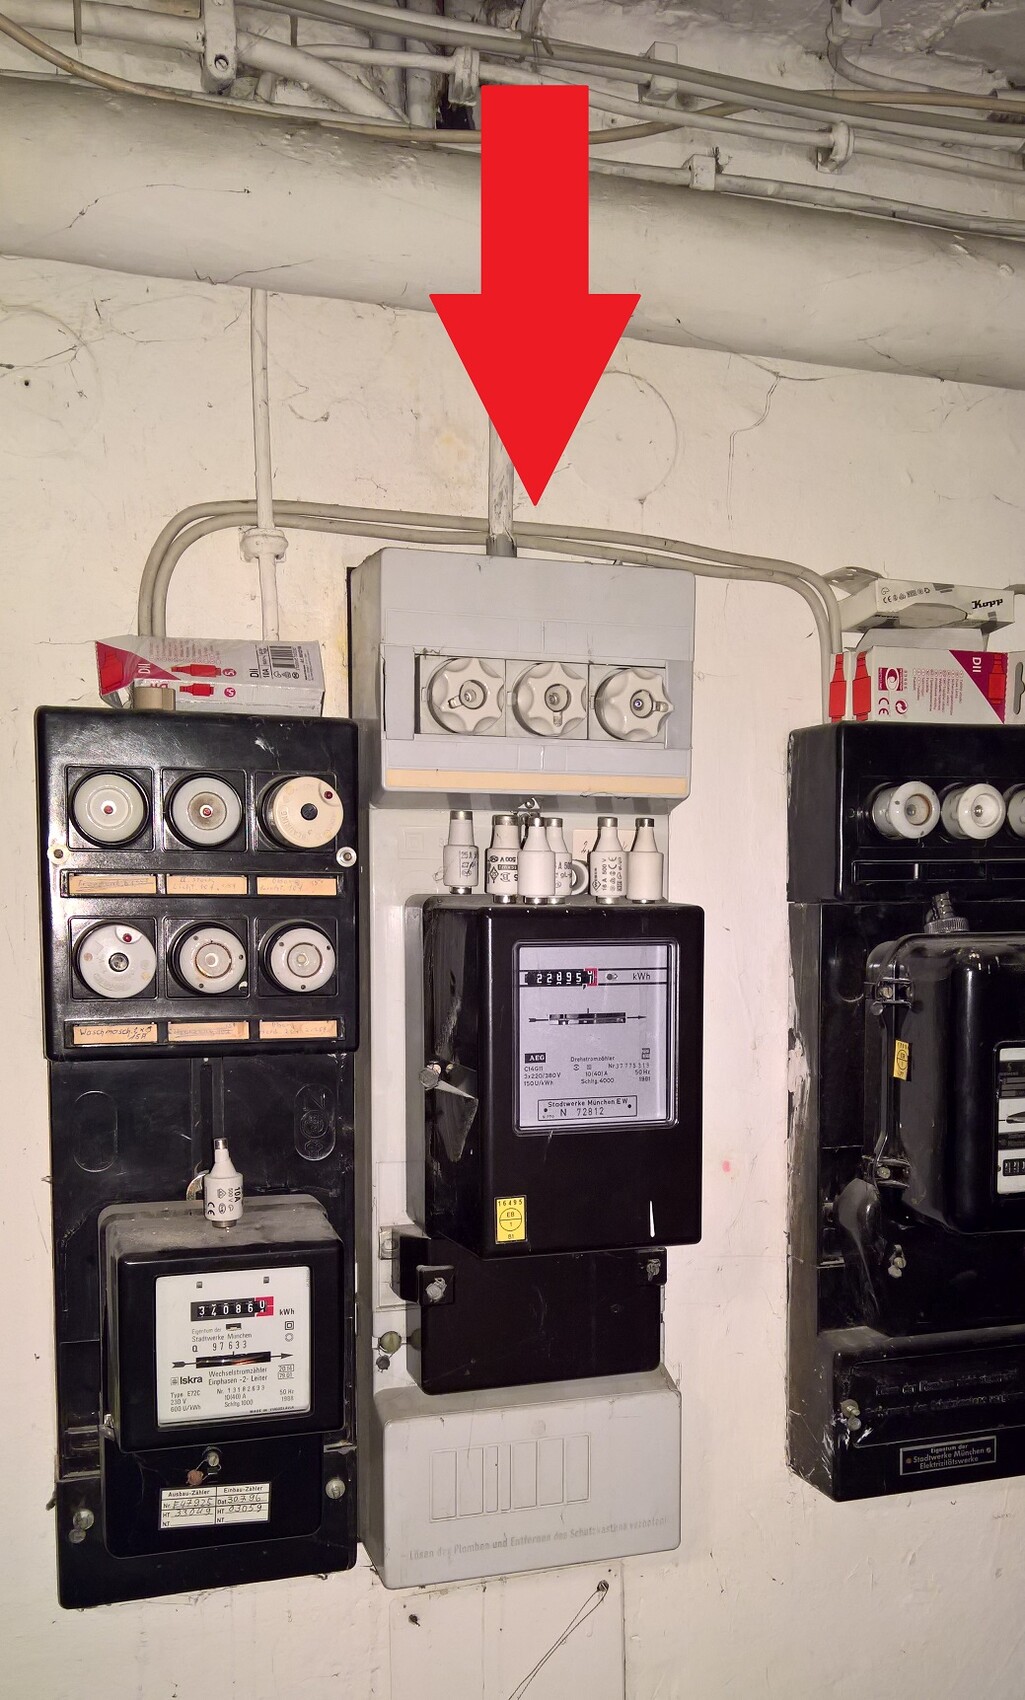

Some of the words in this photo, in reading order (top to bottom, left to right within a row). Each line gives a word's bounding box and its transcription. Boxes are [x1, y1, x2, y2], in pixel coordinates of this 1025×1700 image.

[972, 598, 1003, 610] Kopp
[972, 657, 982, 673] DII
[632, 972, 651, 980] kWh
[528, 1053, 546, 1062] AEG
[576, 1107, 605, 1116] 72812
[279, 1308, 295, 1316] kWh
[192, 1335, 225, 1343] Stadtwerke
[212, 1340, 247, 1351] 97633
[208, 1367, 268, 1378] Wechselstromzähler
[180, 1376, 203, 1385] Iskra
[208, 1377, 238, 1386] Einphasen
[913, 1453, 952, 1463] Stadtwerke
[953, 1448, 985, 1458] München
[920, 1457, 979, 1470] Elektrizitätswerke
[168, 1489, 210, 1498] Ausbau-Zähler
[223, 1485, 263, 1493] Einbau-Zähler
[492, 1537, 508, 1549] und
